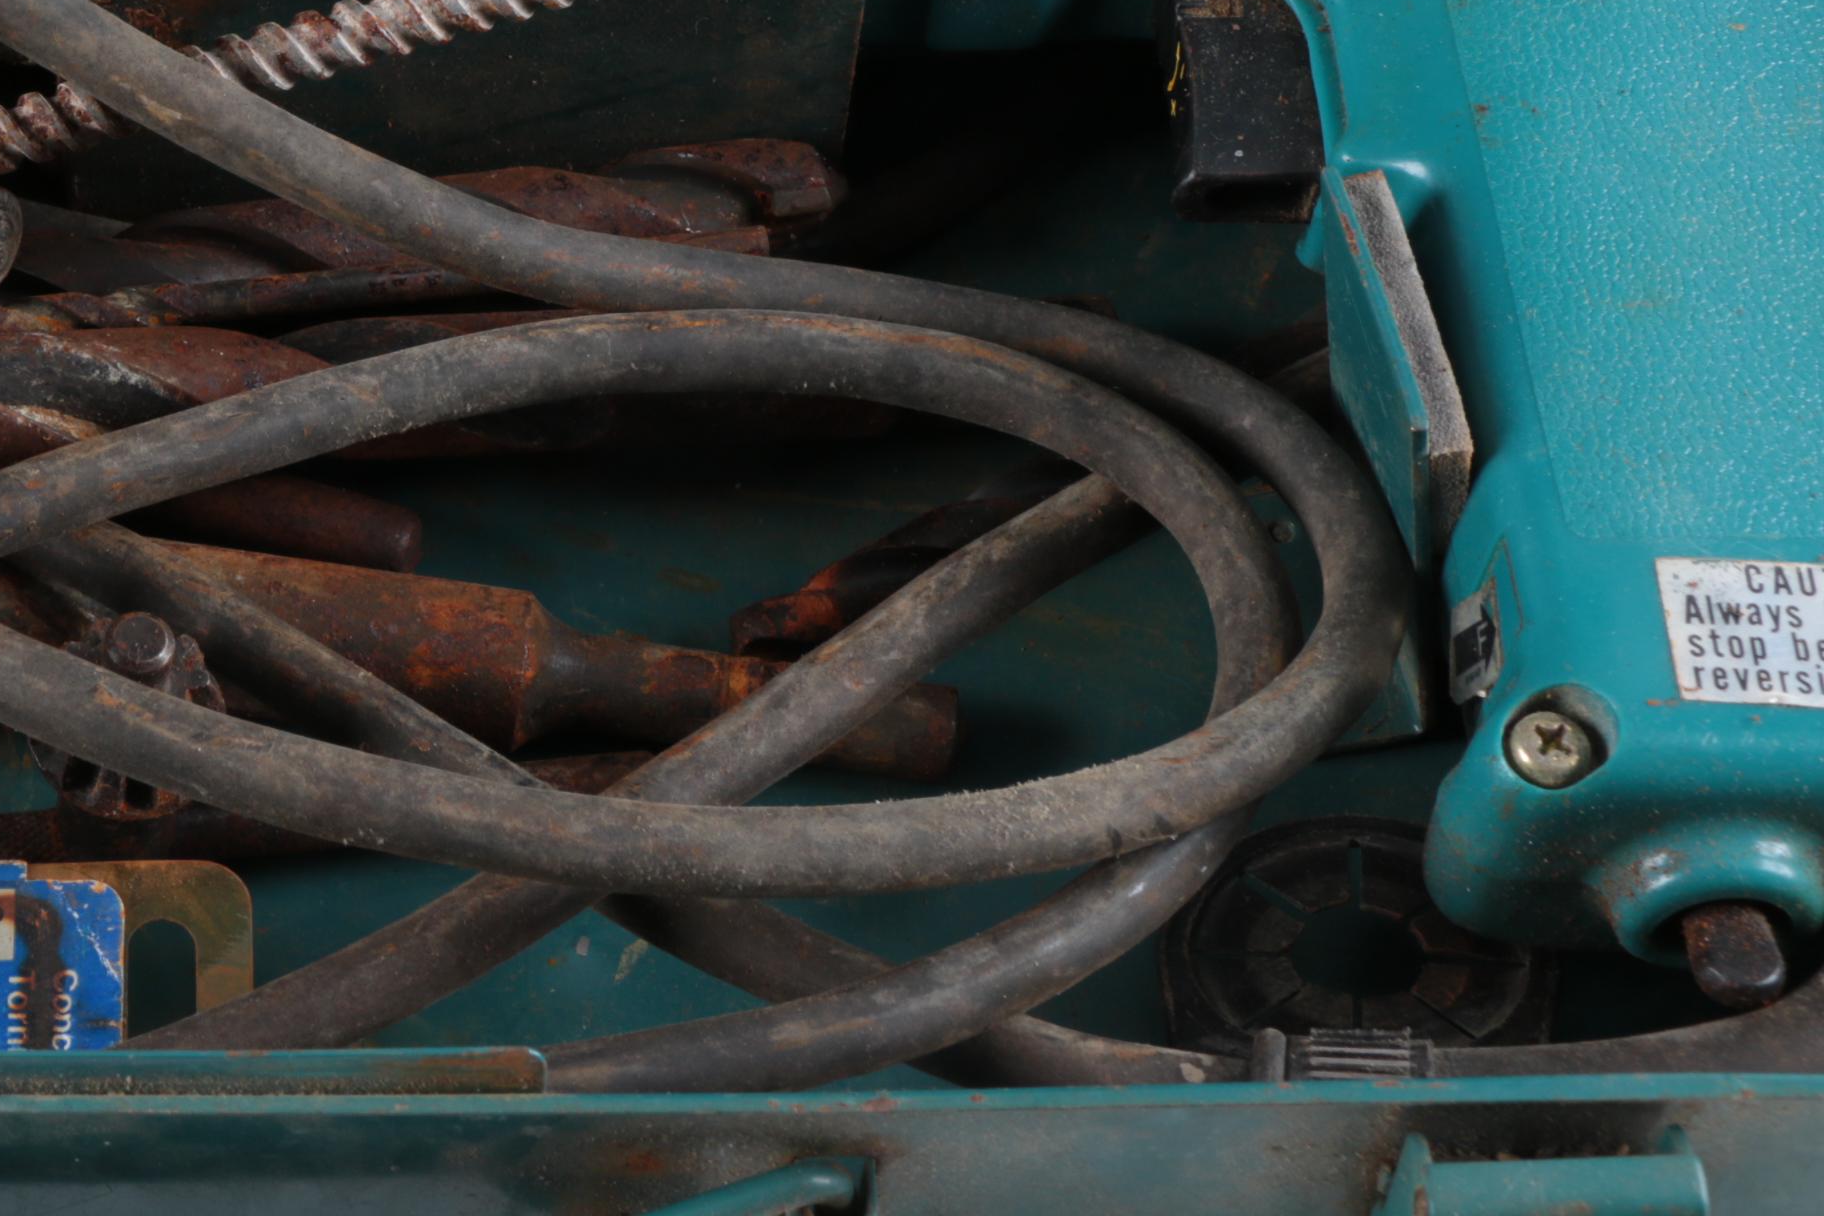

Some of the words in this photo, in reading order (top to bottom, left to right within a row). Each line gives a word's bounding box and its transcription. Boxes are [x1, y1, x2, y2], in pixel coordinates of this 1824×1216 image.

[1744, 563, 1824, 596] CAU
[1685, 594, 1804, 633] Always
[1688, 629, 1768, 666] stop
